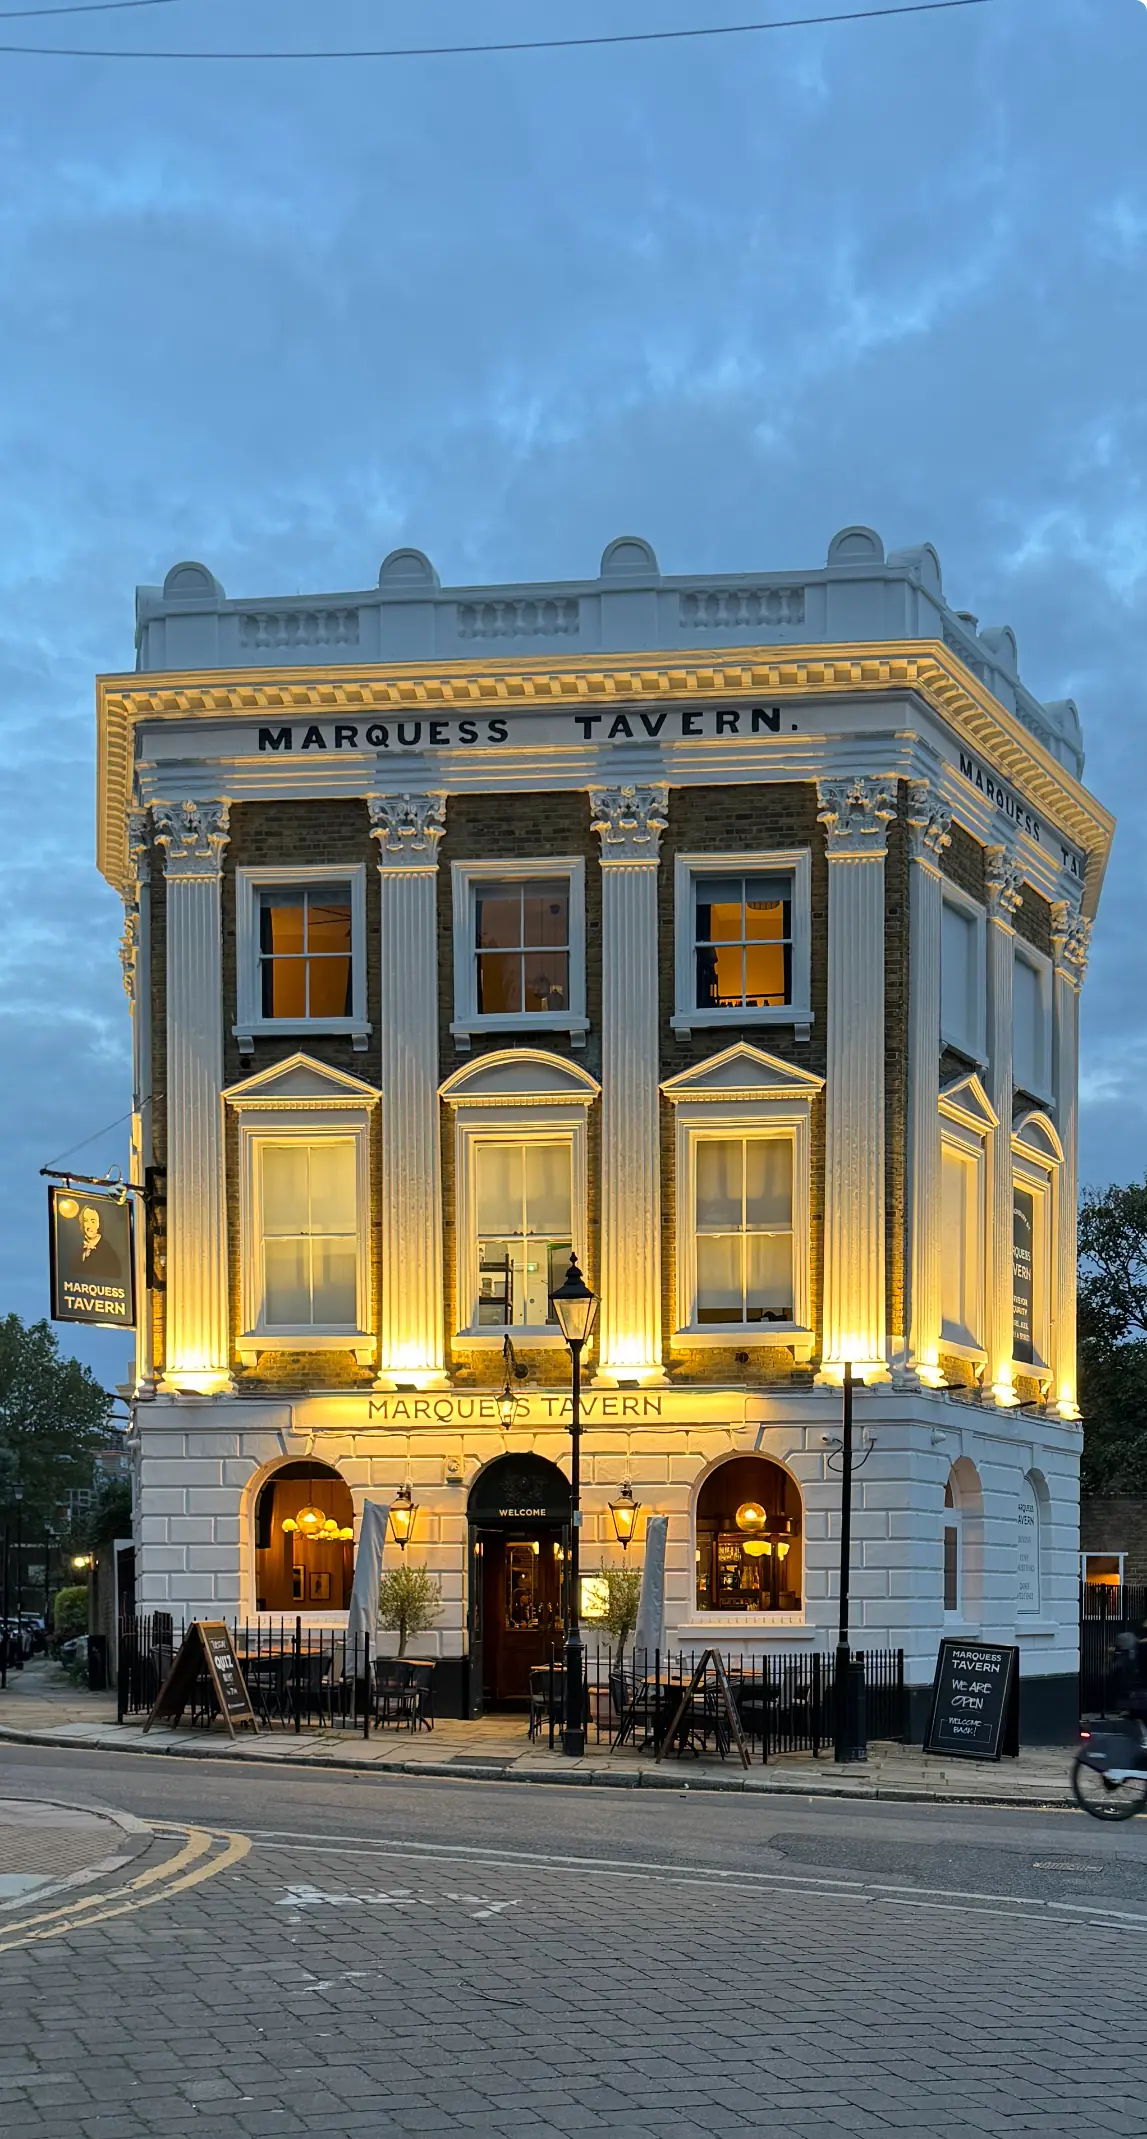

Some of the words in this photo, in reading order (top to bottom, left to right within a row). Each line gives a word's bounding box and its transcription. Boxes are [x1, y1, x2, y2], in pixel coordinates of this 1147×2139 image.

[258, 719, 509, 751] MARQUESS
[574, 707, 799, 740] TAVERN.
[959, 753, 1041, 842] MARQUESS
[63, 1281, 125, 1299] MARQUESS
[64, 1296, 126, 1316] TAVERN
[368, 1398, 531, 1423] MARQUES
[498, 1508, 547, 1517] WELCOME
[214, 1654, 234, 1672] QUIZ
[952, 1650, 1002, 1662] MARQUESS
[951, 1660, 1000, 1673] TAVERN
[952, 1679, 969, 1691] WE
[968, 1681, 992, 1694] ARE
[951, 1695, 984, 1710] OPEN
[948, 1717, 983, 1727] WELCOME
[953, 1726, 977, 1737] BACK!
